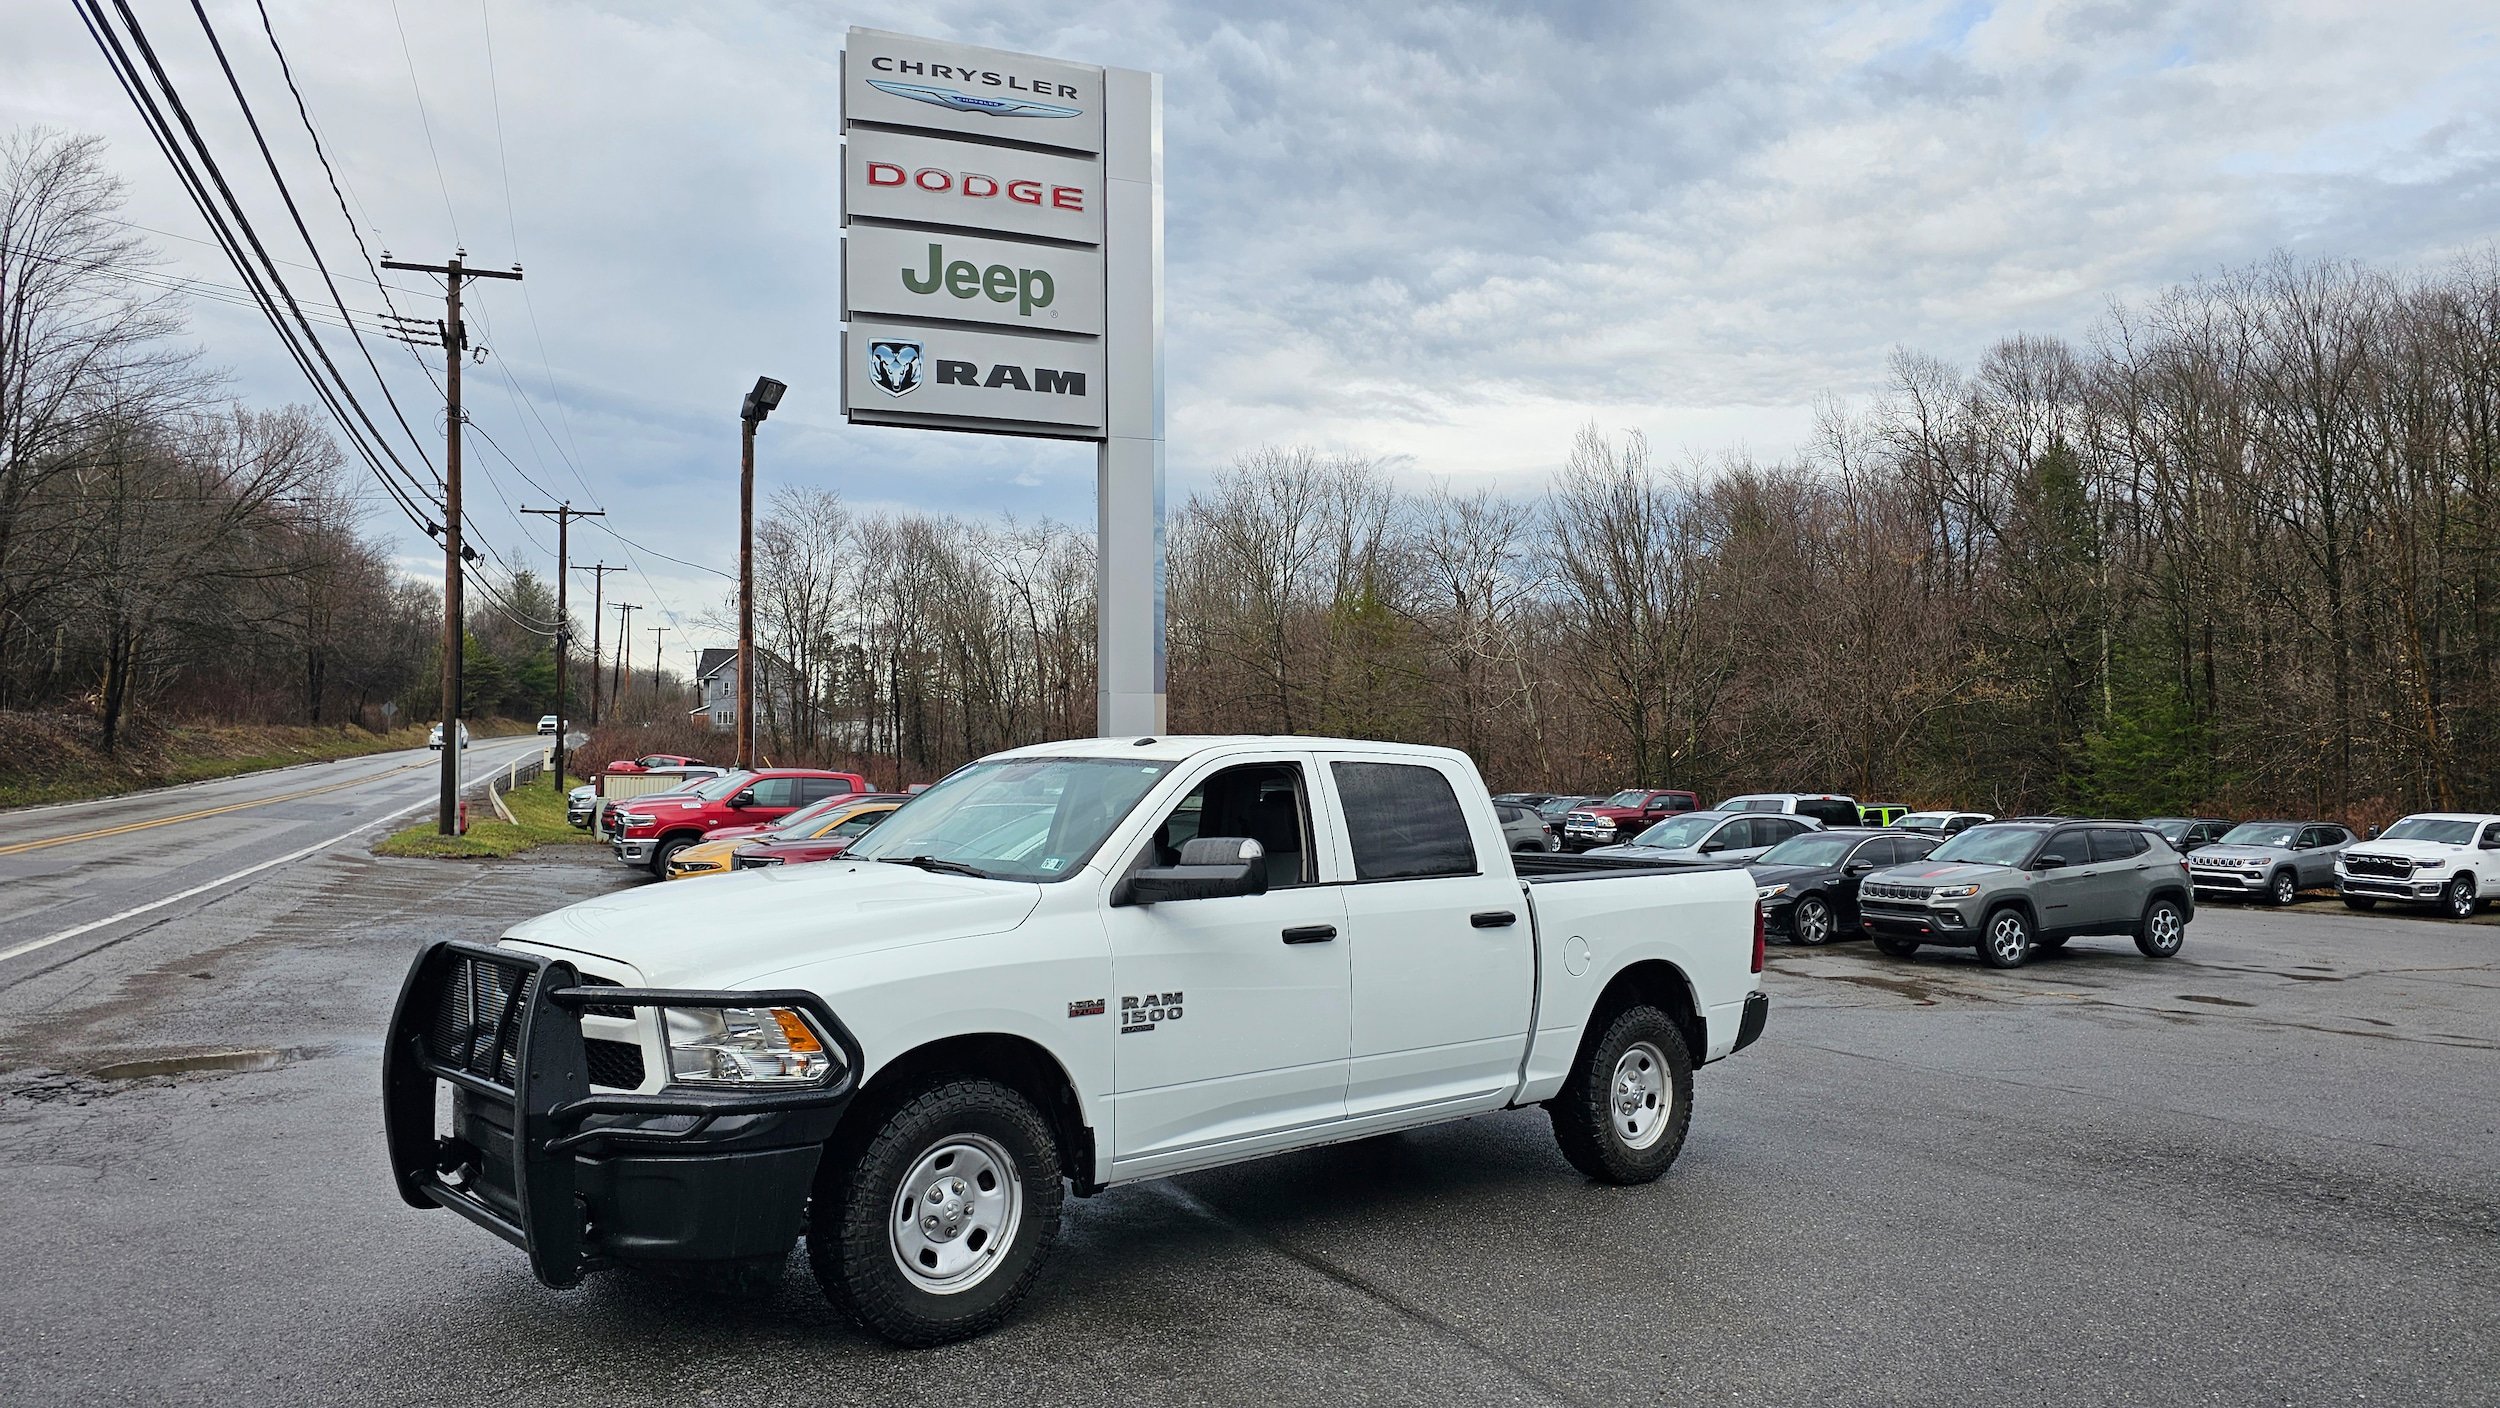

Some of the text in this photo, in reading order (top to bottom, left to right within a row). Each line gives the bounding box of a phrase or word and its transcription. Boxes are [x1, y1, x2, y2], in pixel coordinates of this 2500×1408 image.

[871, 56, 1078, 100] CHRYSLER
[866, 160, 1085, 212] DODGE
[901, 243, 1055, 317] Jeep
[936, 359, 1086, 397] RAM
[1121, 991, 1183, 1011] RAM
[1121, 1006, 1183, 1025] 1500
